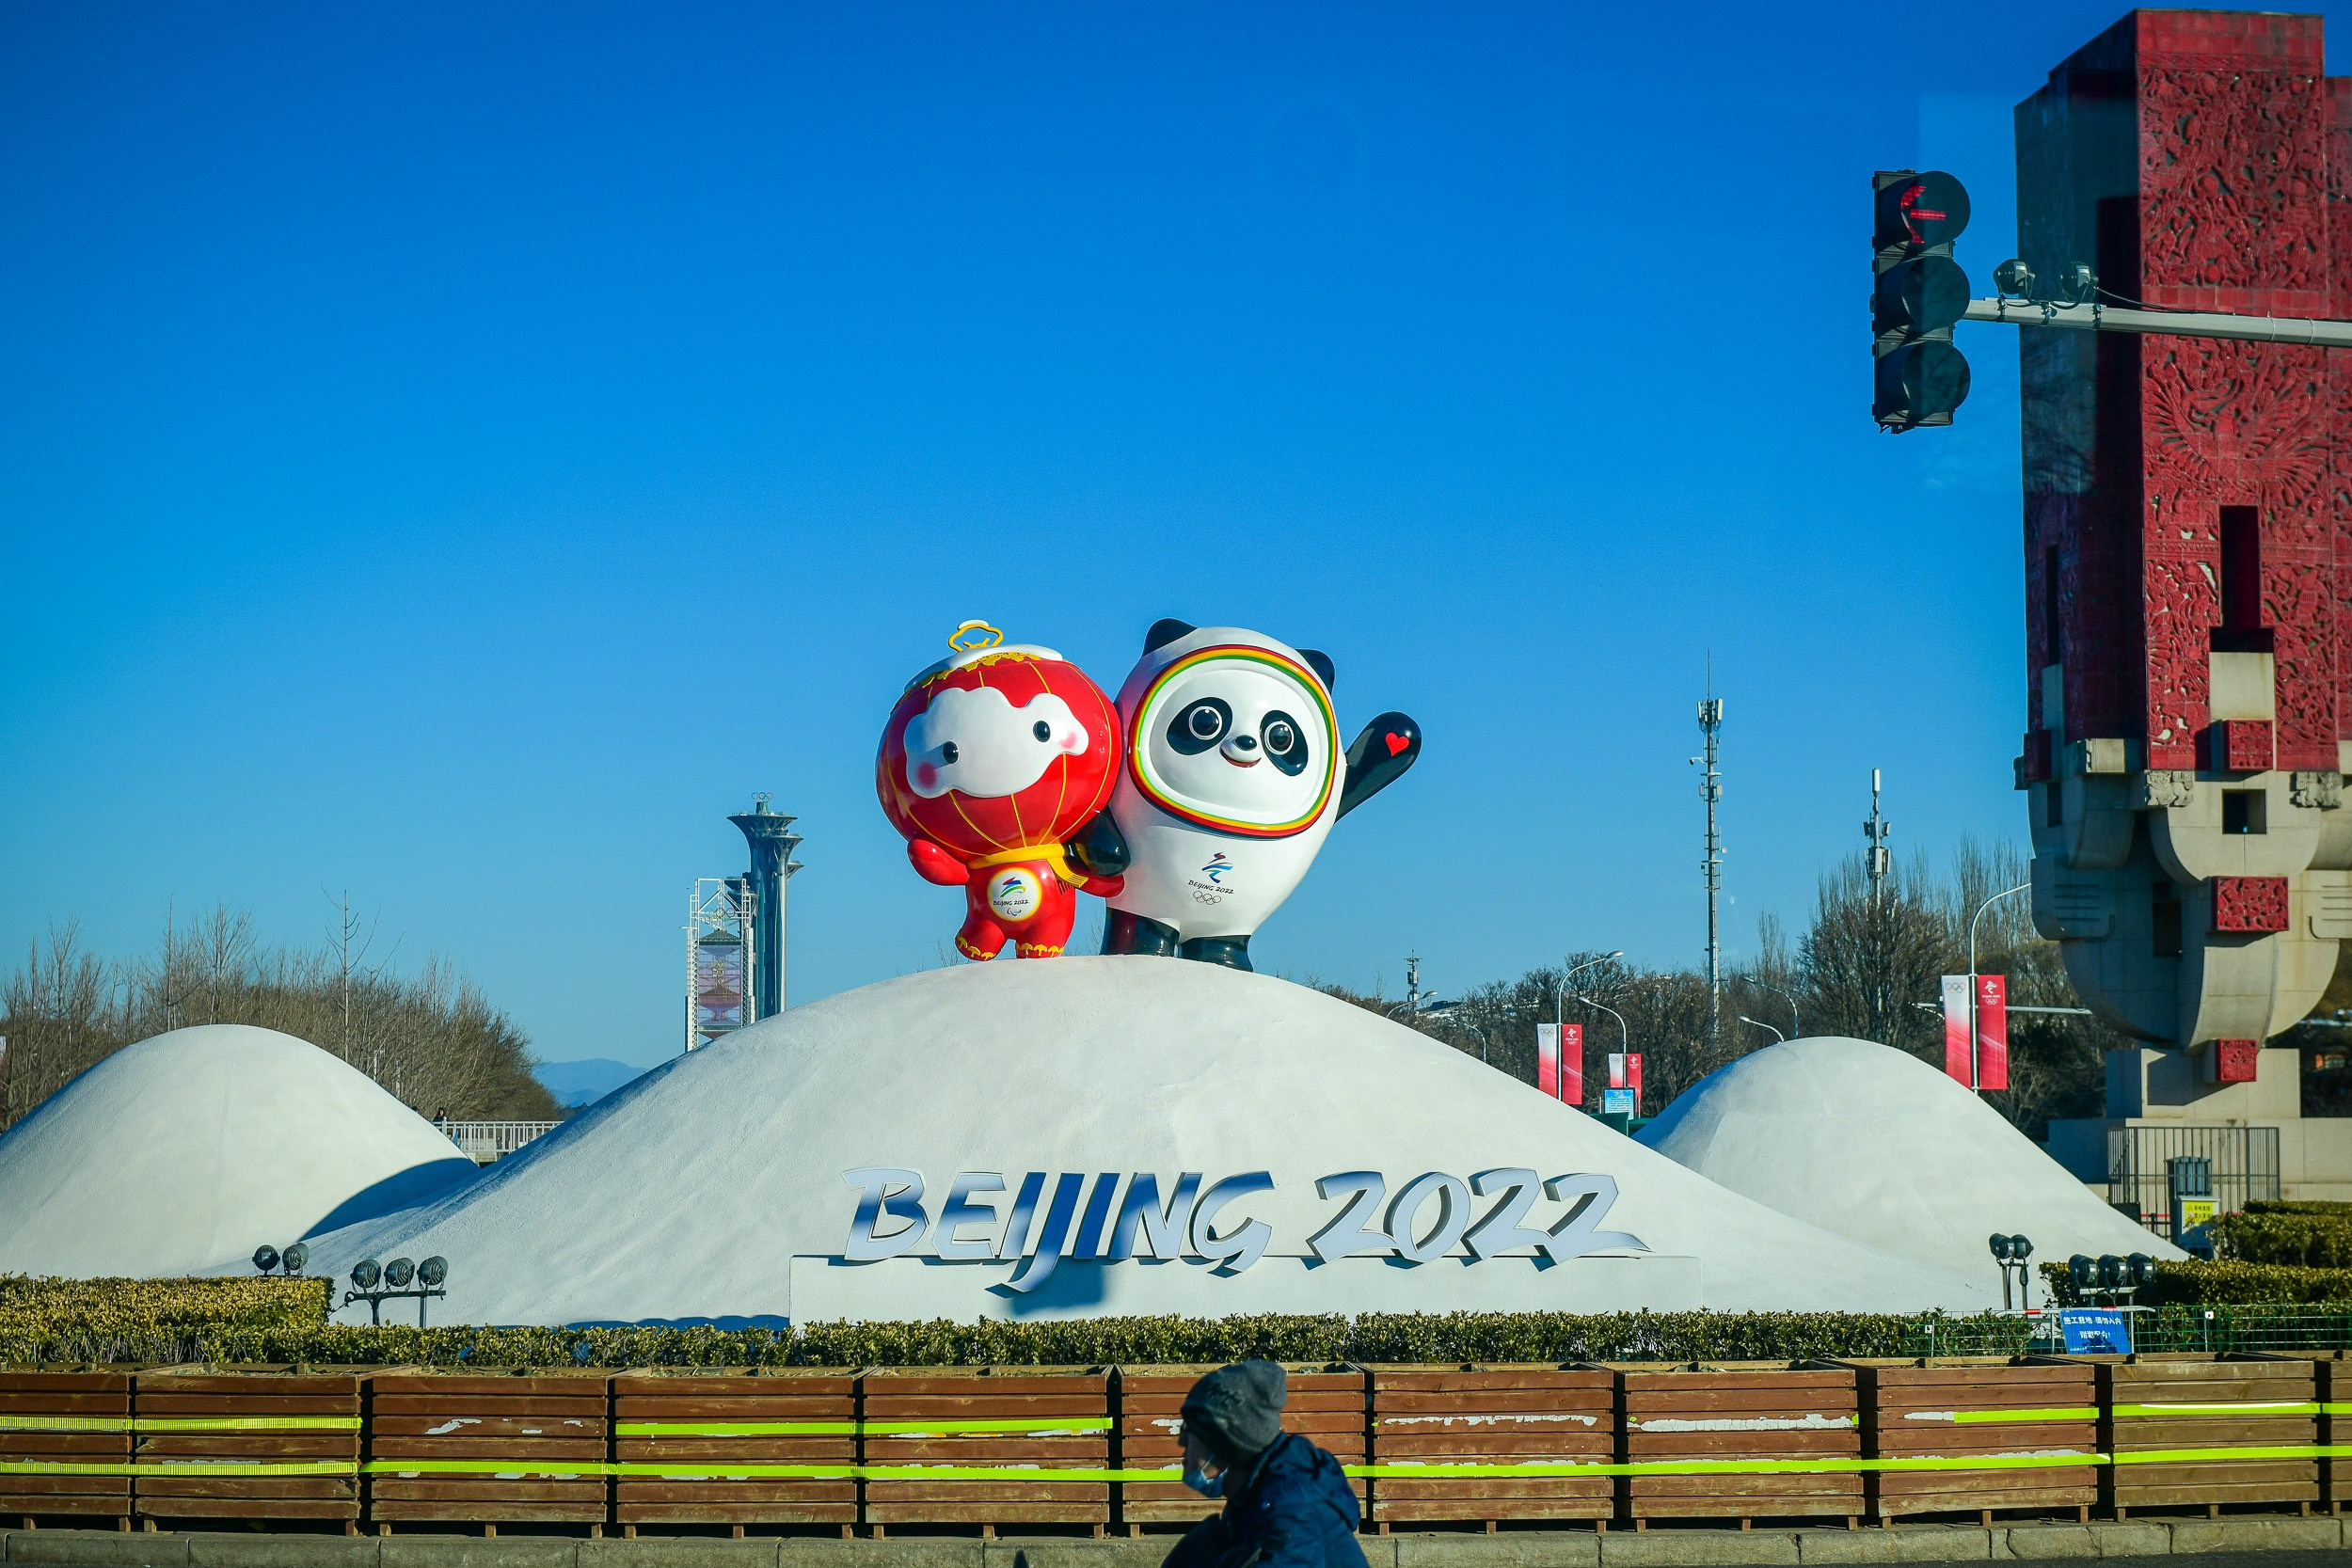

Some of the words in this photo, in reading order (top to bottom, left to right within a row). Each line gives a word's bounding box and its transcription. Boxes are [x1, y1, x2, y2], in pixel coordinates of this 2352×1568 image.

[1187, 879, 1215, 892] BEIJING
[1216, 886, 1234, 895] 2022
[842, 1167, 1275, 1293] BEIJING
[1307, 1167, 1651, 1265] 2022
